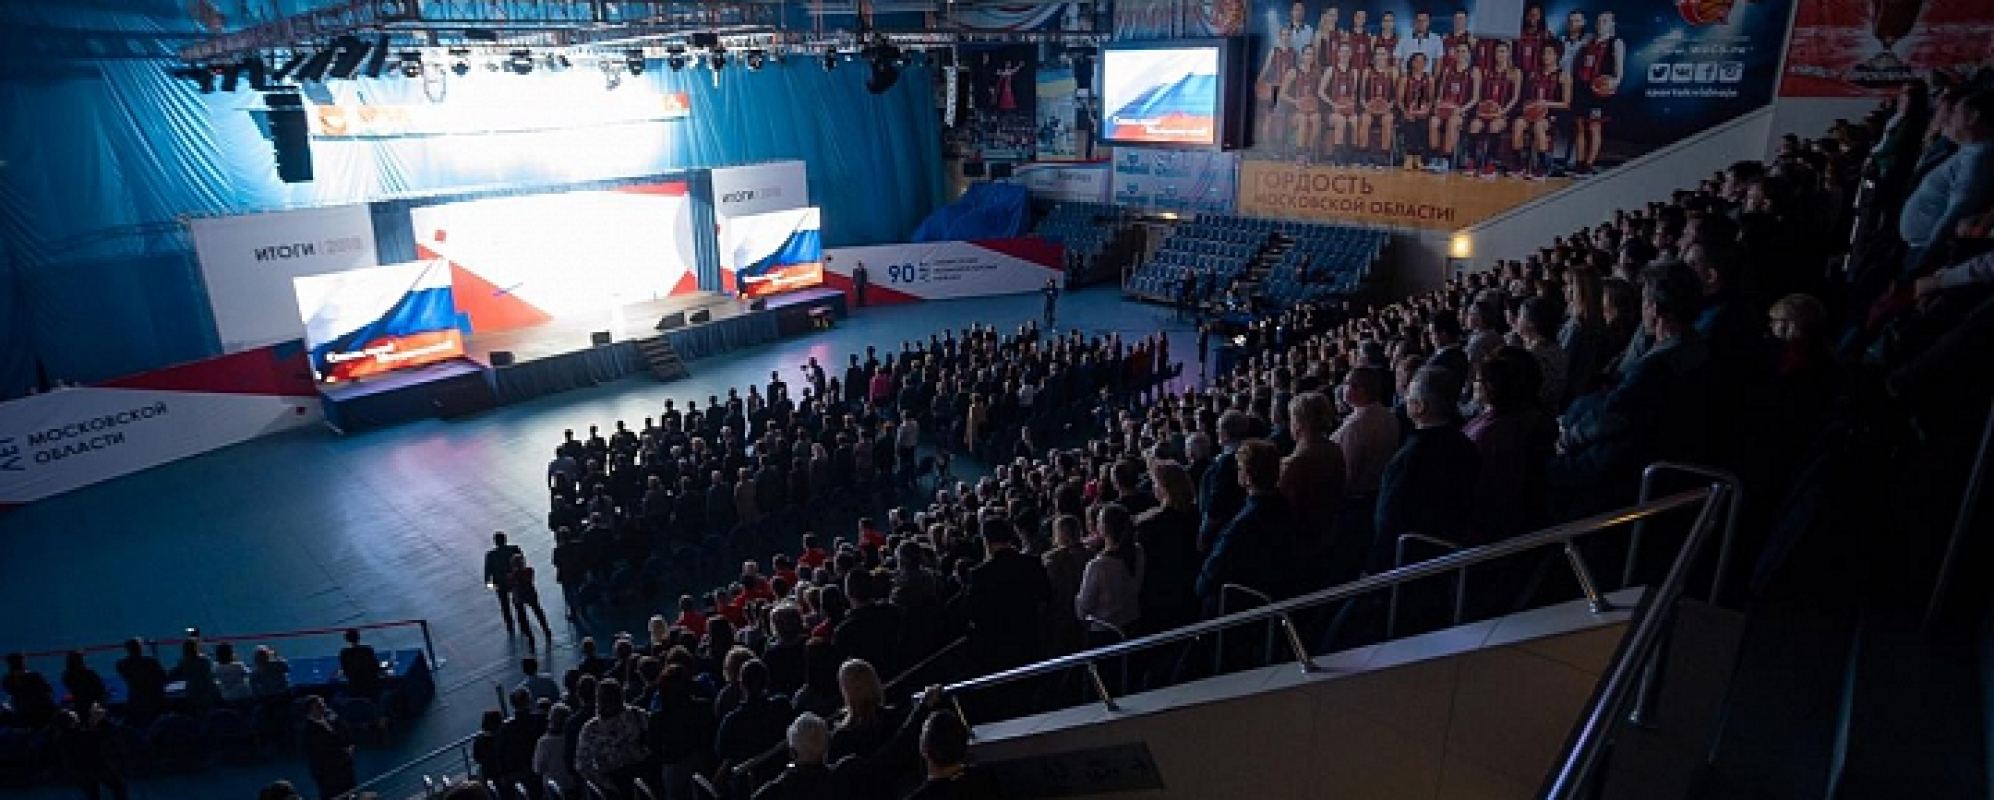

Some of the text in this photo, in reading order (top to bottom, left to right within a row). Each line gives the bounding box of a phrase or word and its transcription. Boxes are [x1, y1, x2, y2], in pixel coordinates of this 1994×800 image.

[1255, 170, 1374, 195] ГОРДОСТЬ
[1255, 192, 1365, 212] МОСКОВСКОЙ
[254, 243, 314, 261] ИТОГИ
[888, 262, 915, 283] 90
[28, 401, 168, 446] МОСКОВСКОЙ
[35, 432, 125, 463] ОБЛАСТИ
